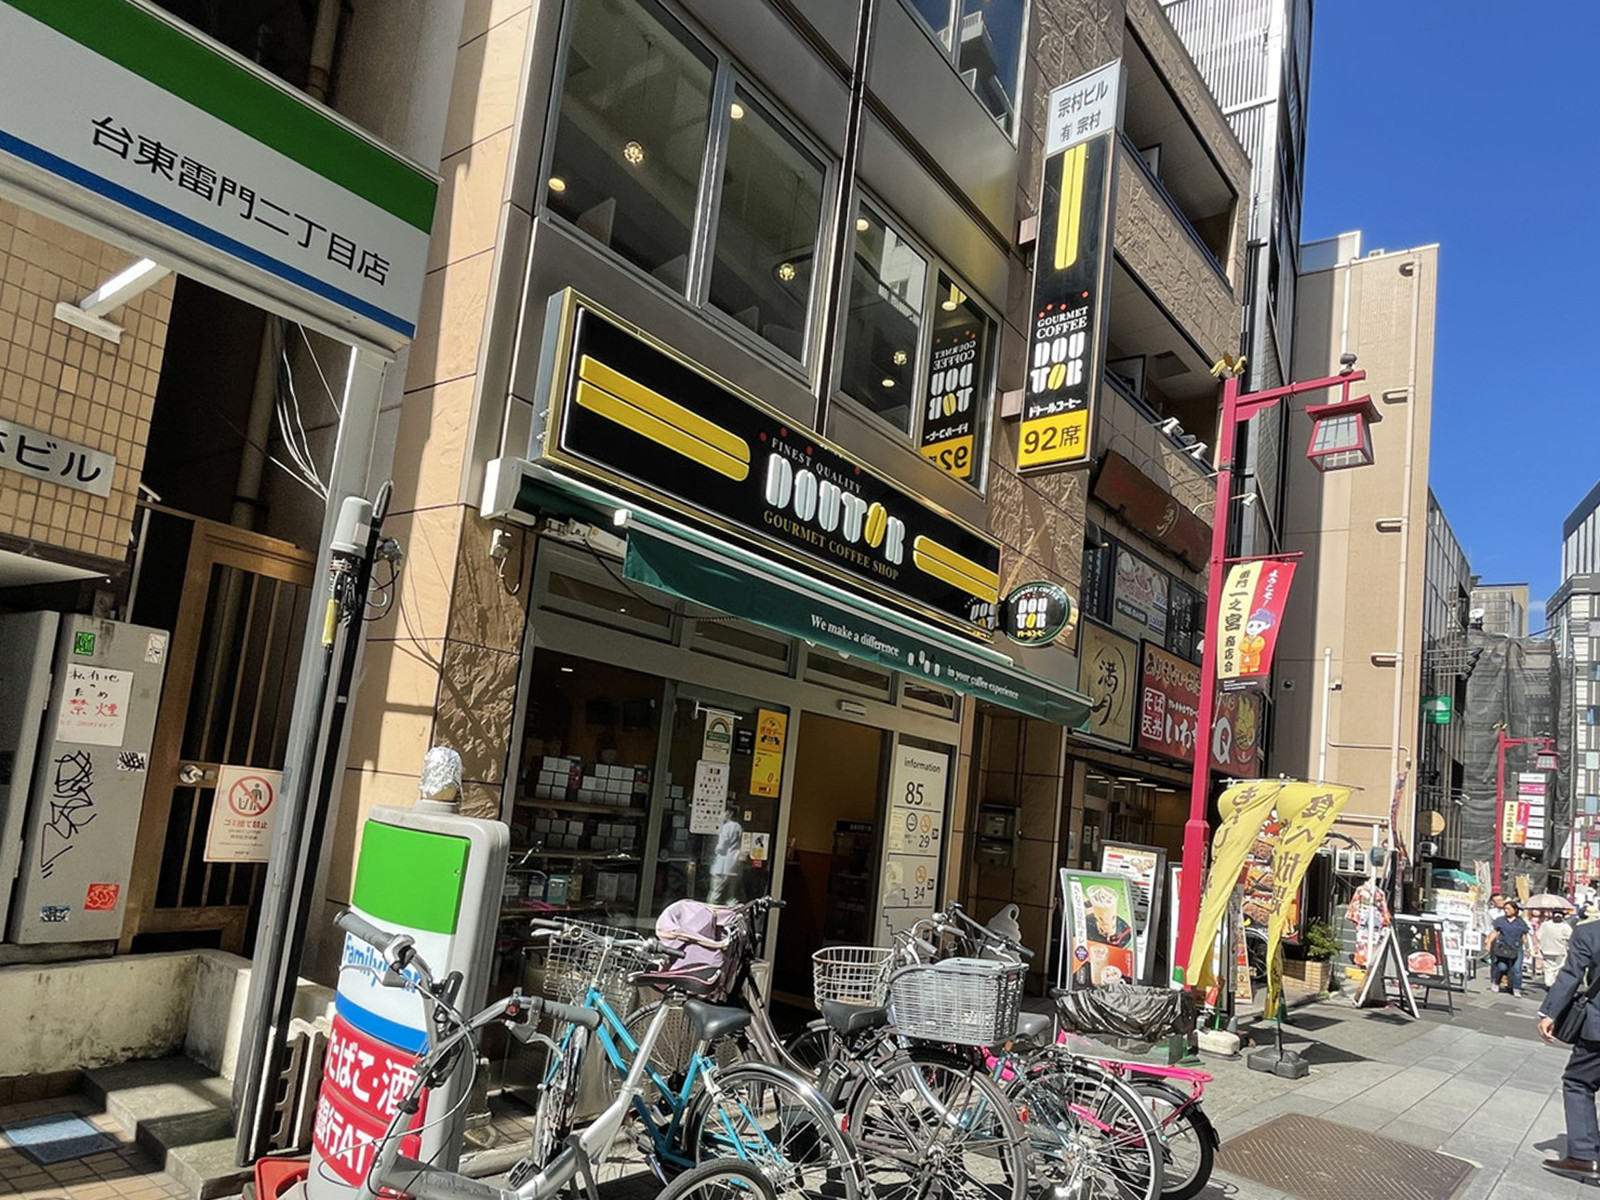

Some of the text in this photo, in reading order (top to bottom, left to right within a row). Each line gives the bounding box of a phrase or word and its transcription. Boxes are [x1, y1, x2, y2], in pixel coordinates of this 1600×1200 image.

[91, 116, 391, 286] 台東雷門二丁目店
[1036, 316, 1088, 339] COFFEE
[1037, 306, 1088, 328] GOURMET
[1029, 398, 1082, 418] ドトールコーヒー
[1024, 424, 1082, 455] 92席
[771, 437, 862, 494] FINEST QUALITY
[766, 453, 906, 566] DOUTOR
[763, 510, 900, 581] GOURMET COFFEE SHOP
[811, 614, 900, 657] We make a difference
[947, 665, 1019, 700] in your coffee experience
[904, 757, 942, 774] information
[904, 781, 924, 806] 85
[918, 834, 931, 849] 29
[913, 886, 925, 900] 34
[315, 1093, 386, 1175] 銀行AT
